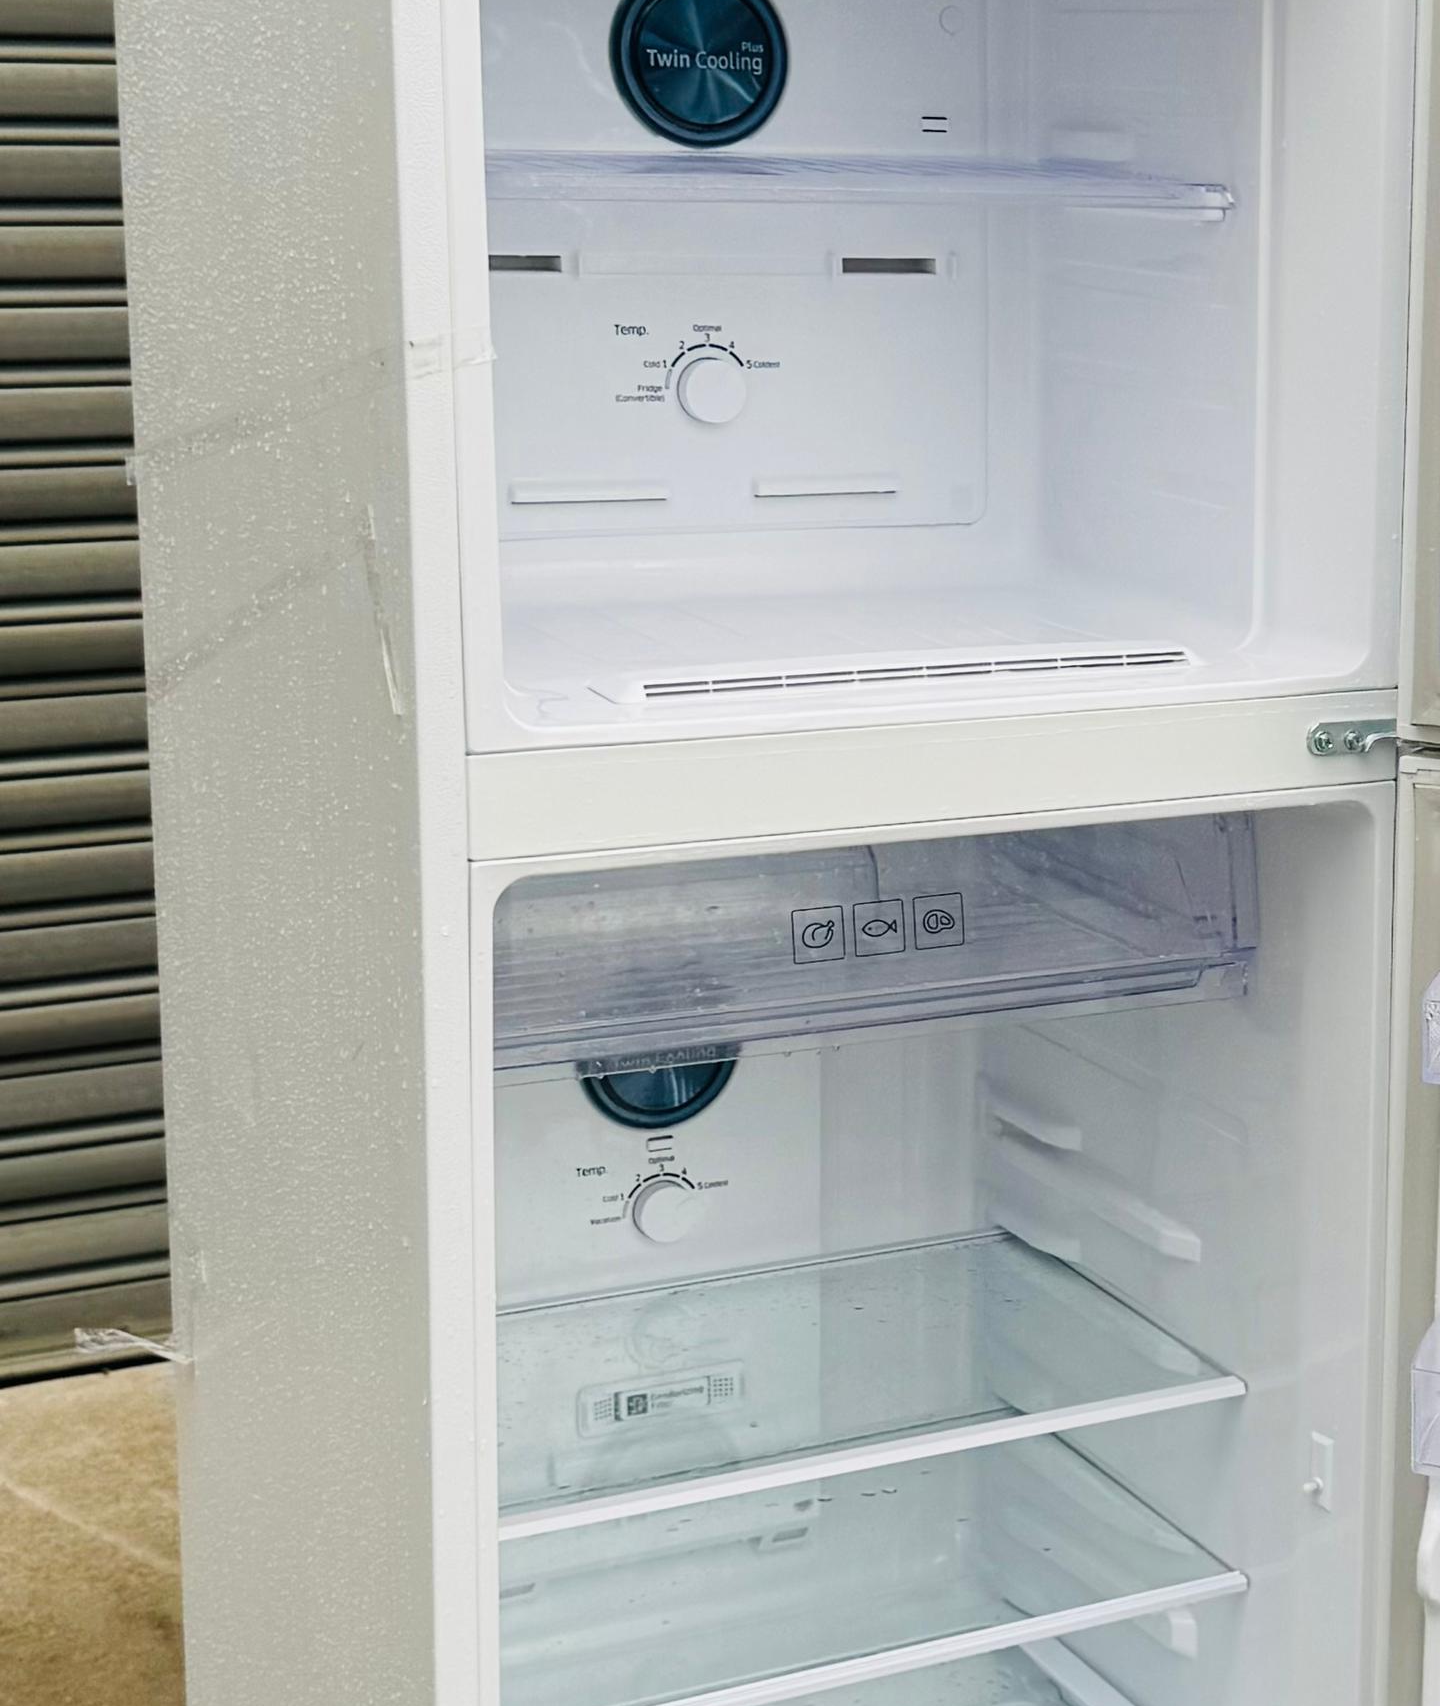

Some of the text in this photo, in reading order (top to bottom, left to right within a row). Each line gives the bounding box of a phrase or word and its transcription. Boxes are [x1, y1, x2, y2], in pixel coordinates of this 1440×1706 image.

[741, 42, 764, 53] Plus
[646, 48, 763, 75] Twin Cooling
[614, 324, 649, 336] Temp.
[704, 333, 711, 342] 3
[678, 340, 685, 350] 2
[728, 341, 736, 349] 4
[746, 360, 753, 369] 5
[637, 384, 663, 393] Fridge
